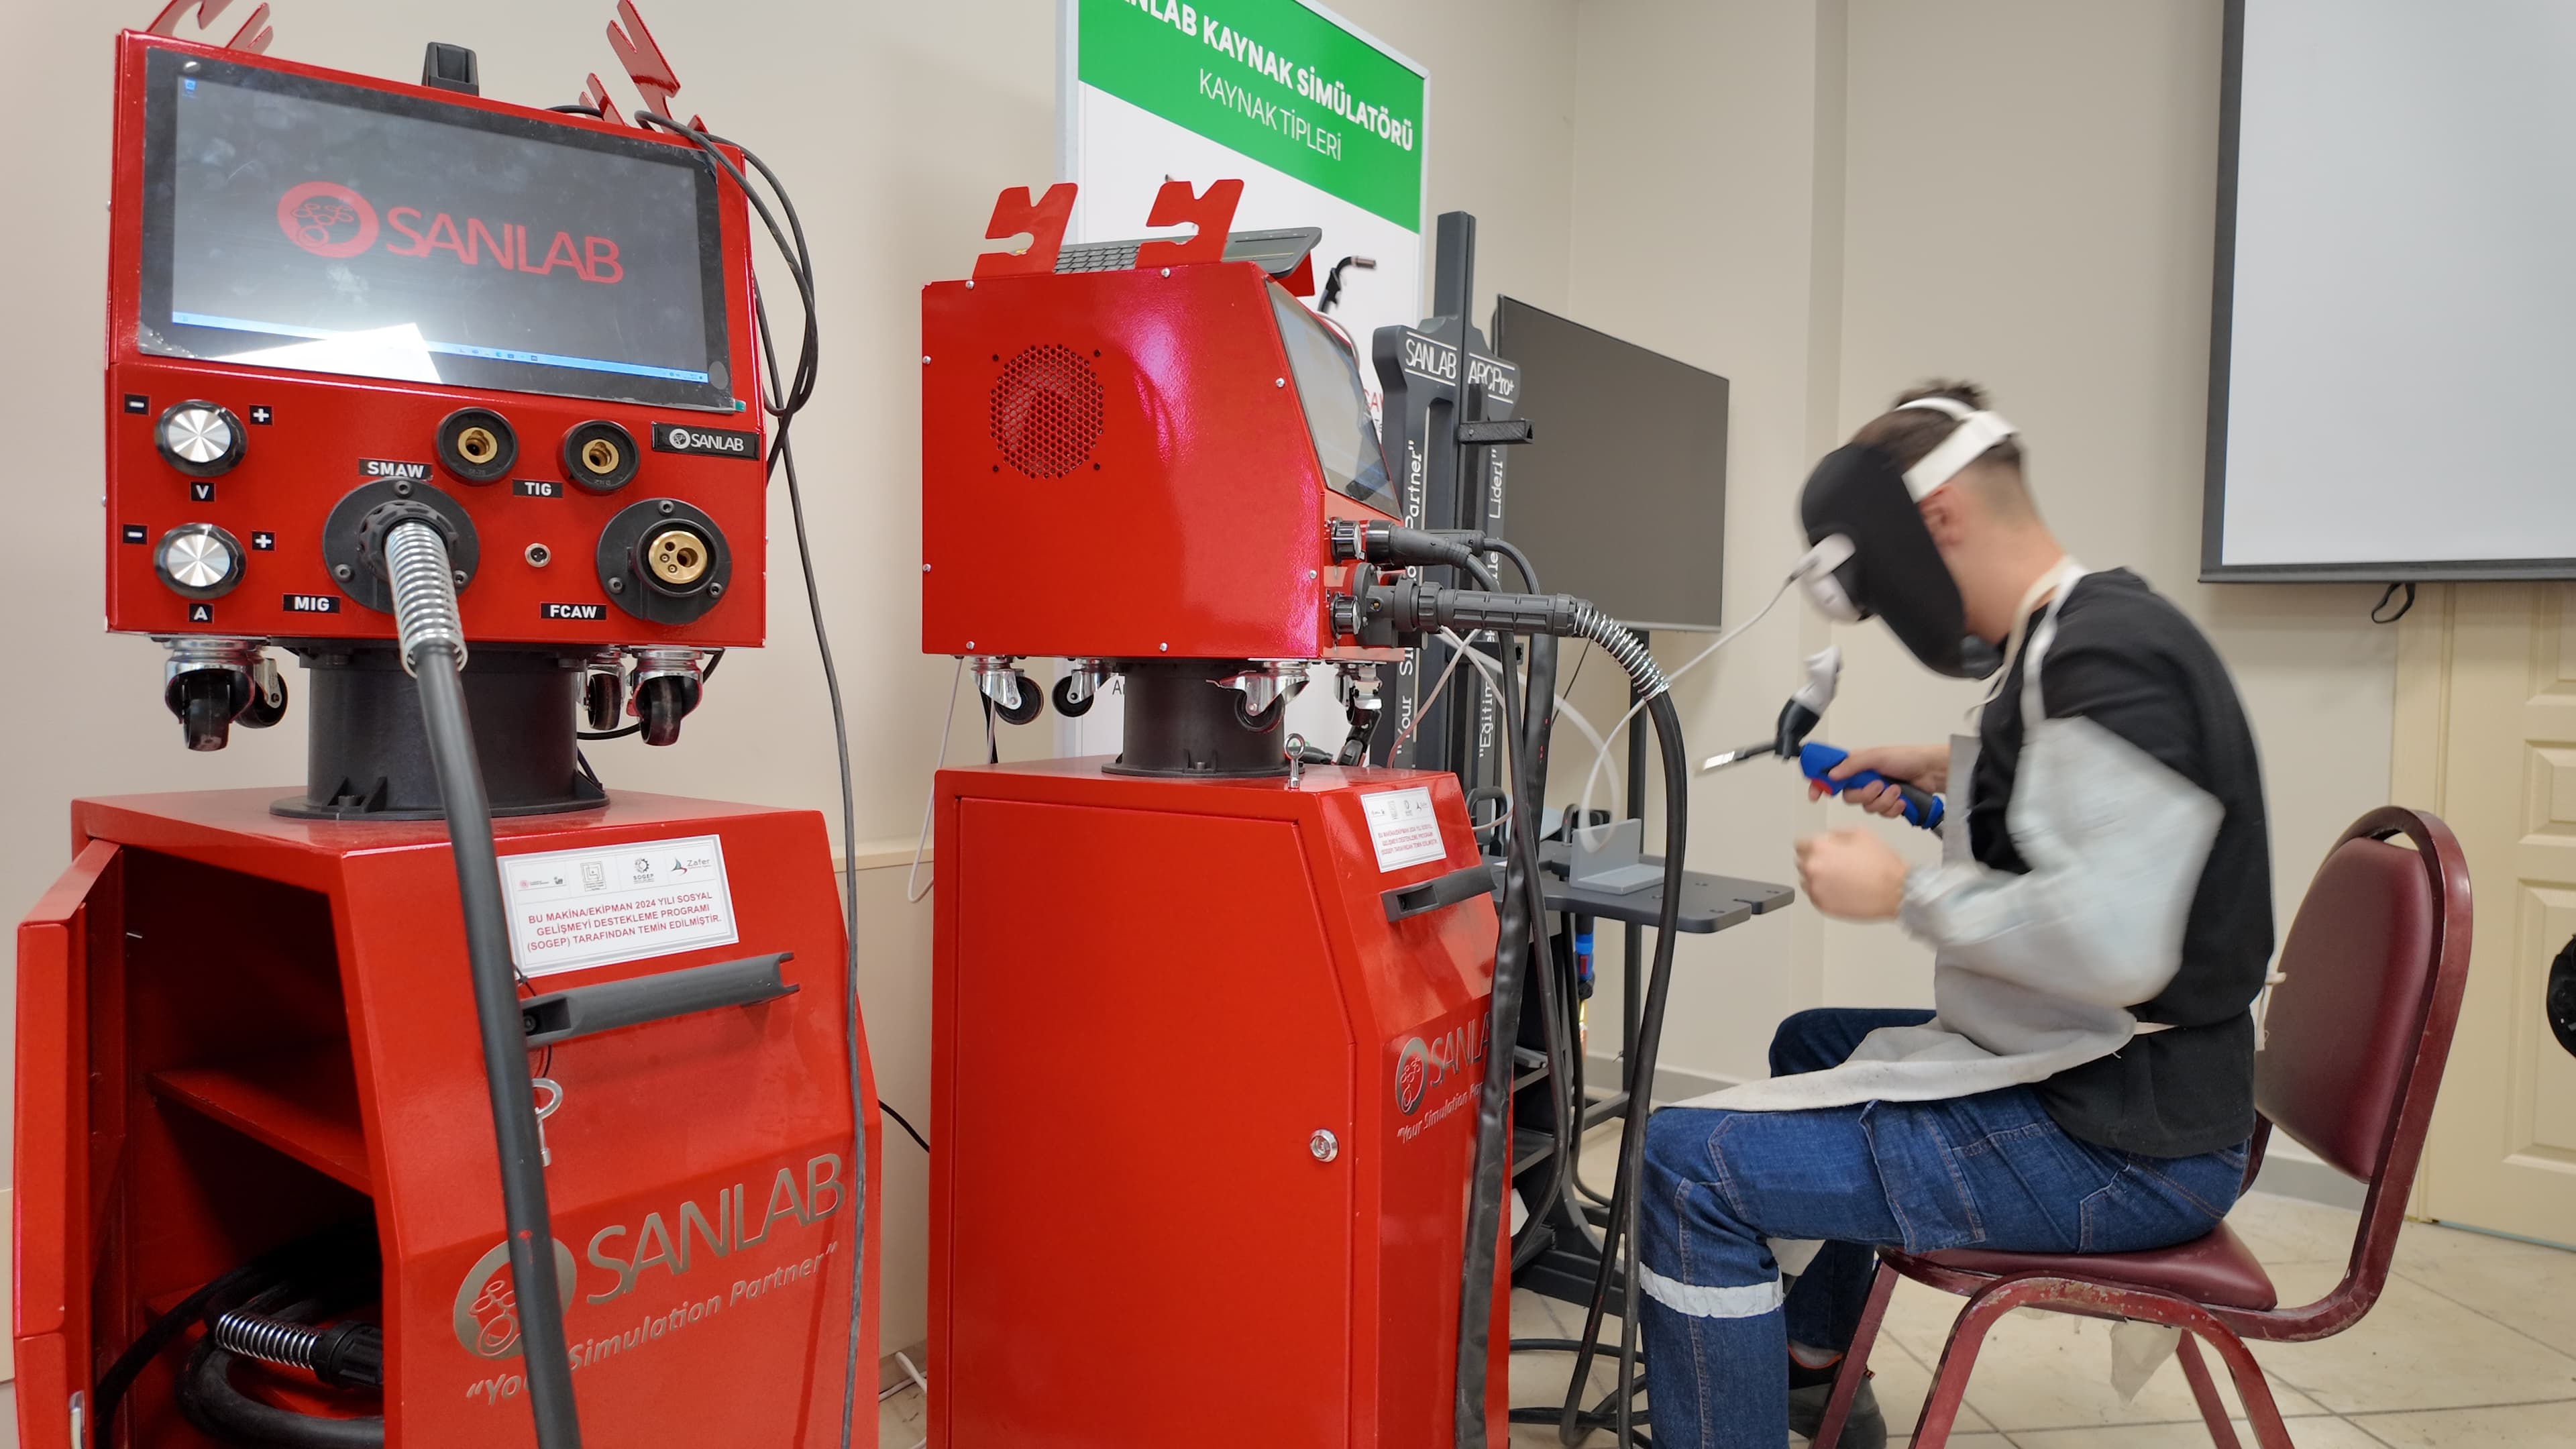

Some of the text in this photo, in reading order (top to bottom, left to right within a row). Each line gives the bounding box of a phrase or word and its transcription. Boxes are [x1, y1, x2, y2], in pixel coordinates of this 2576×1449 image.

[1203, 15, 1293, 89] KAYNAK
[1296, 65, 1413, 152] SİMÜLATÖRÜ
[1199, 68, 1342, 161] KAYNAK TİPLERİ
[385, 207, 624, 284] SANLAB
[1405, 339, 1457, 380] SANLAB
[690, 433, 745, 451] SANLAB
[367, 461, 424, 478] SMAW
[195, 484, 209, 499] V
[524, 481, 552, 496] TIG
[193, 606, 209, 621] A
[294, 596, 330, 612] MIG
[550, 604, 597, 619] FCAW
[686, 858, 710, 867] Zafer
[528, 892, 712, 924] BU MAKİNA/EKİPMAN 2024 YILI SOSYAL
[537, 904, 710, 936] GELİŞMEYİ DESTEKLEME PROGRAMI
[527, 937, 570, 953] (SOGEP)
[573, 927, 635, 944] TARAFINDAN
[638, 921, 667, 934] TEMİN
[1430, 1011, 1491, 1088] SANLA
[1423, 1091, 1468, 1131] Simulation
[587, 1153, 845, 1305] SANLAB
[569, 1293, 722, 1371] Simulation
[729, 1241, 838, 1308] Partner"
